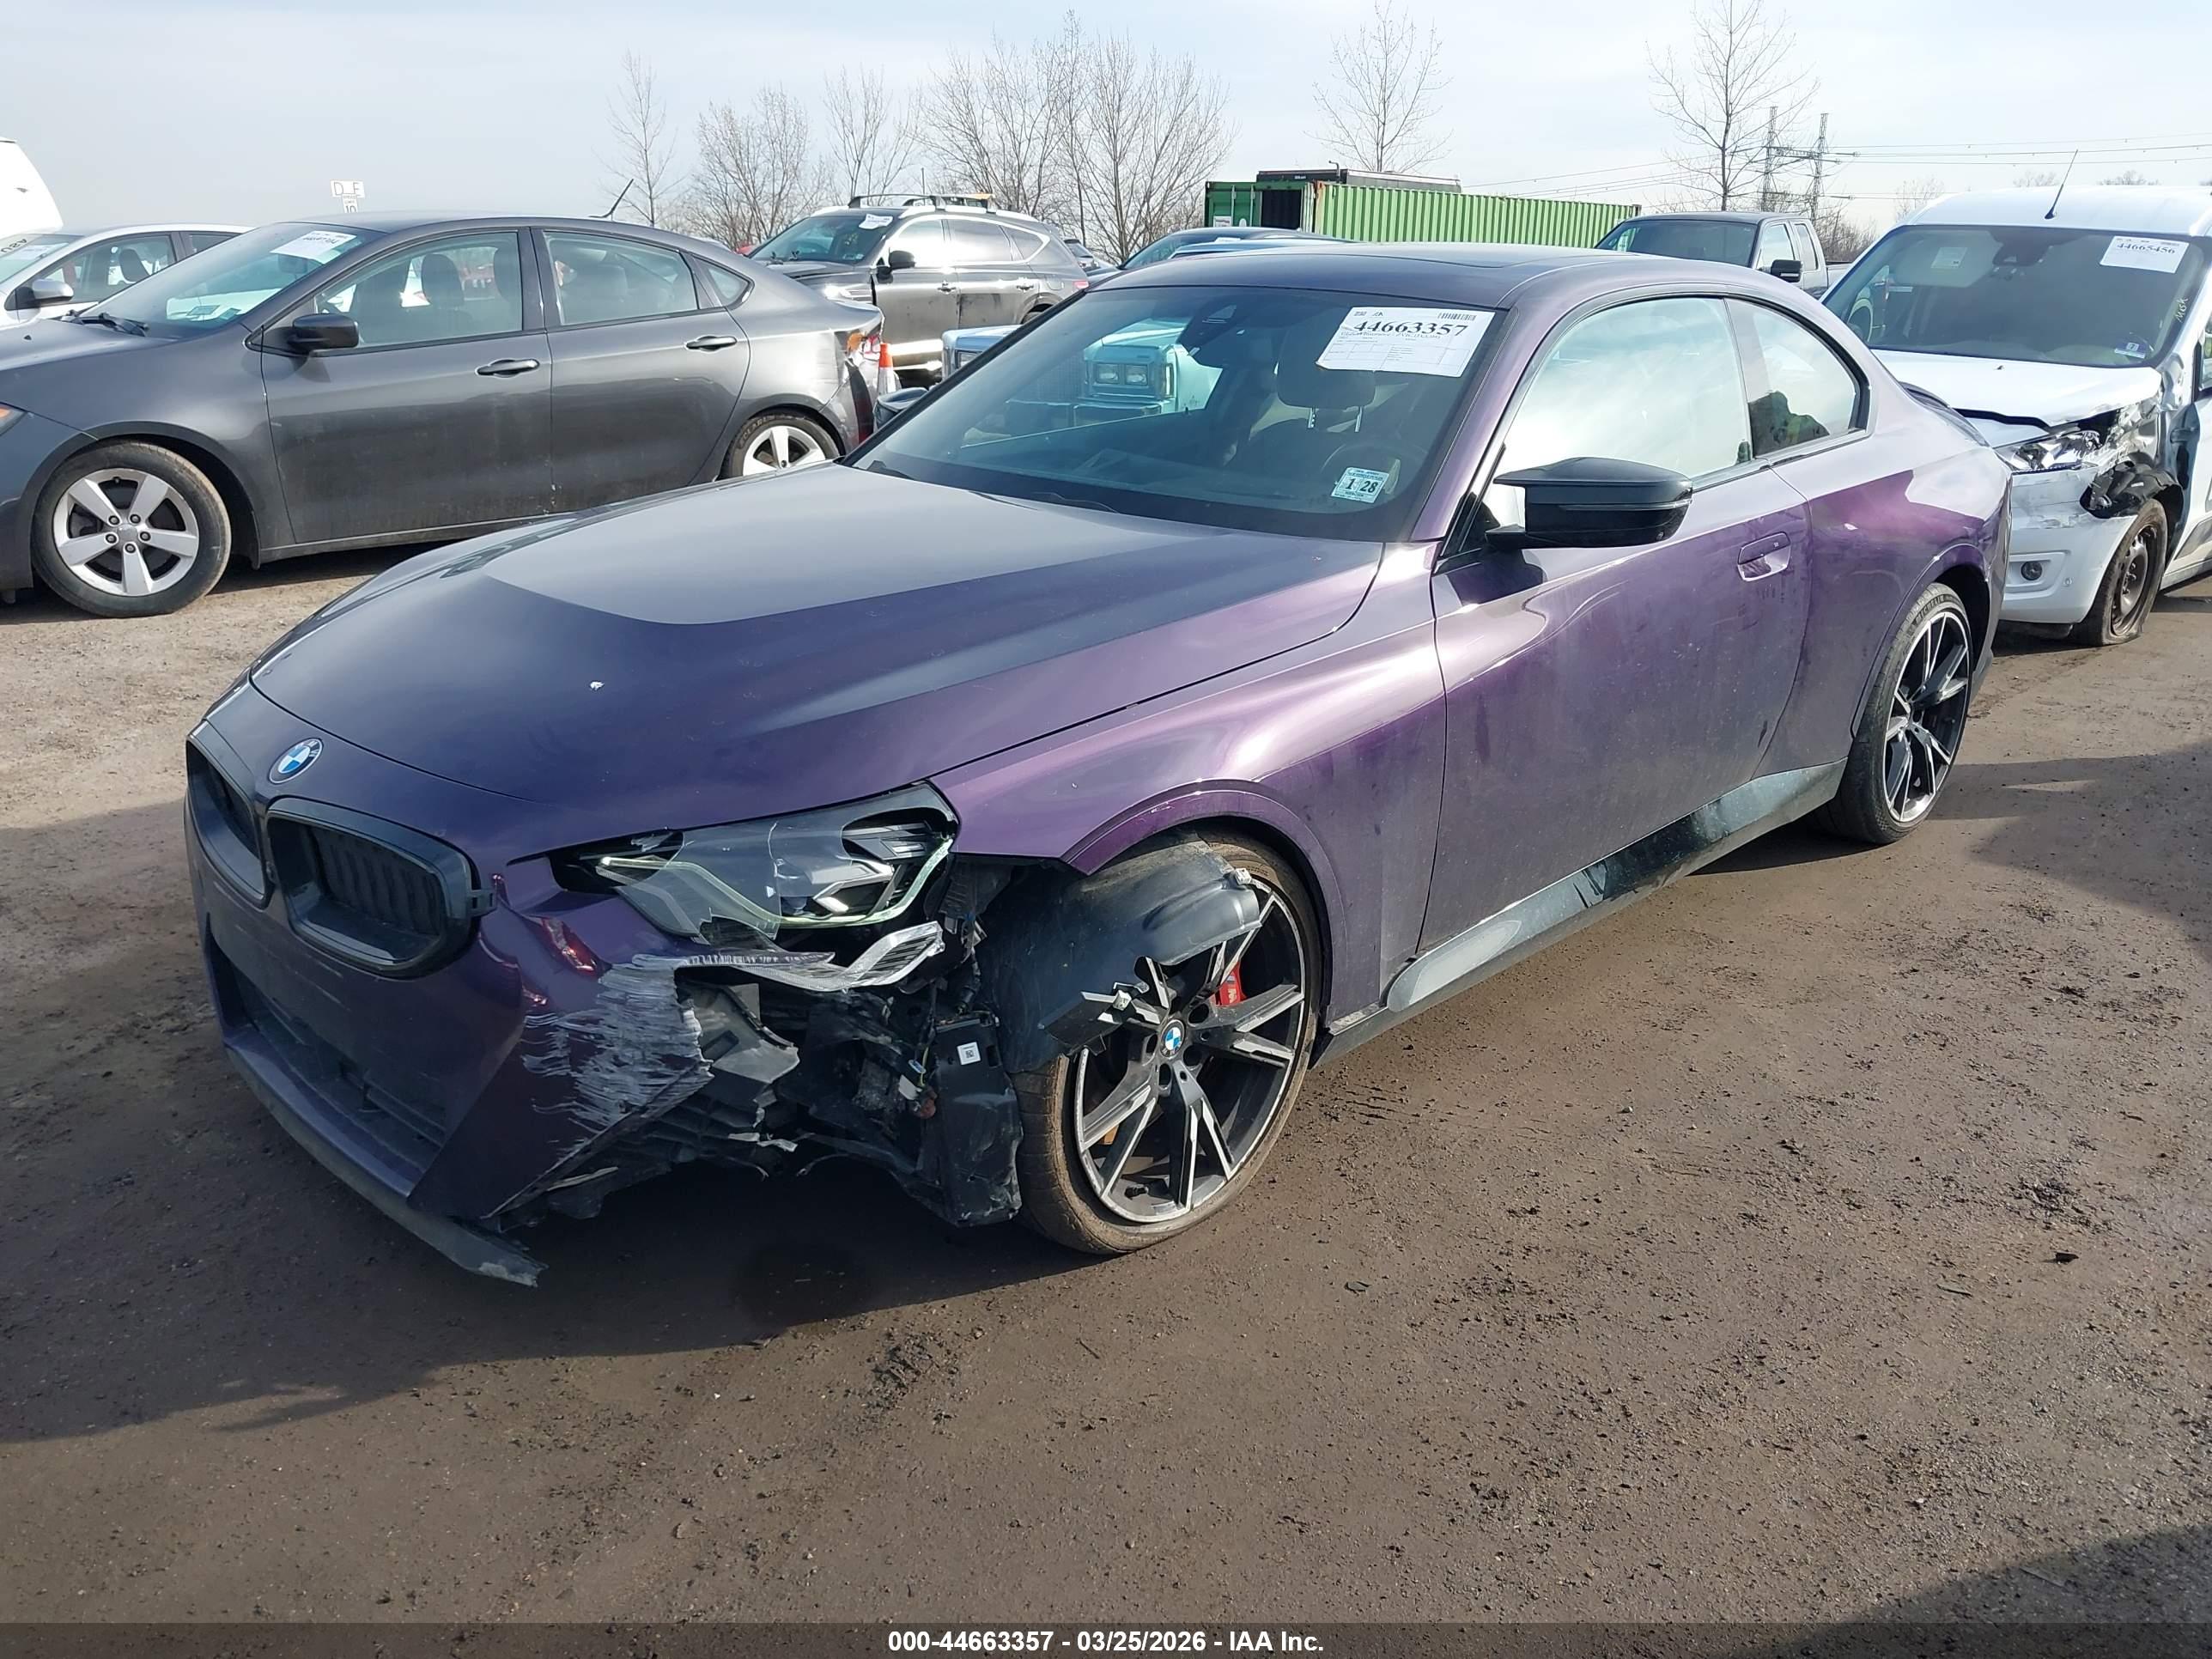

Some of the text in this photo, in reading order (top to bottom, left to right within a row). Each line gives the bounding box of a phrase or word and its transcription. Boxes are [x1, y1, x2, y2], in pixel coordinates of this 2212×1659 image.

[333, 181, 344, 196] D
[1353, 320, 1468, 337] 44663357
[1345, 478, 1378, 493] 1 28
